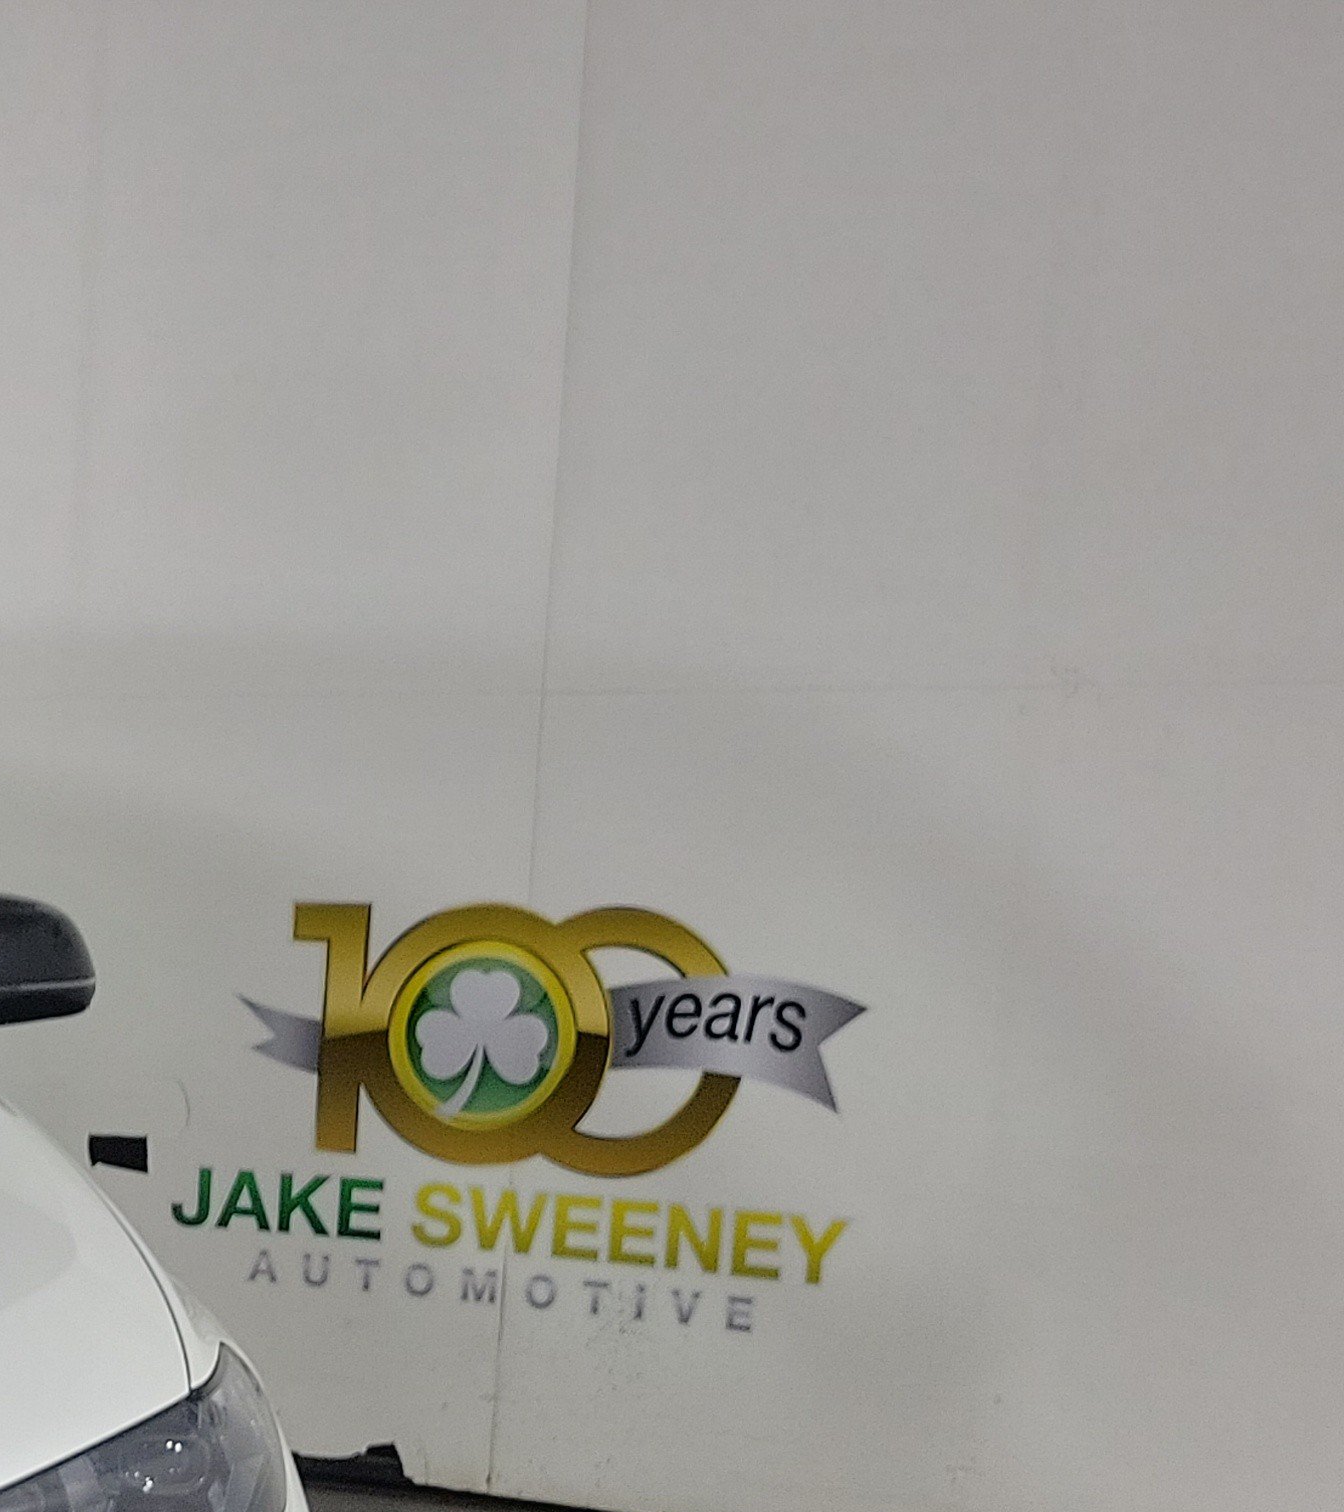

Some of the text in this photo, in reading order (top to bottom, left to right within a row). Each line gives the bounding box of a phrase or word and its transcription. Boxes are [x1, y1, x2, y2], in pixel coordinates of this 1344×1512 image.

[292, 902, 808, 1178] 100 years
[171, 1166, 848, 1286] JAKE SWEENEY
[247, 1249, 756, 1334] AUTOMOTIVE
